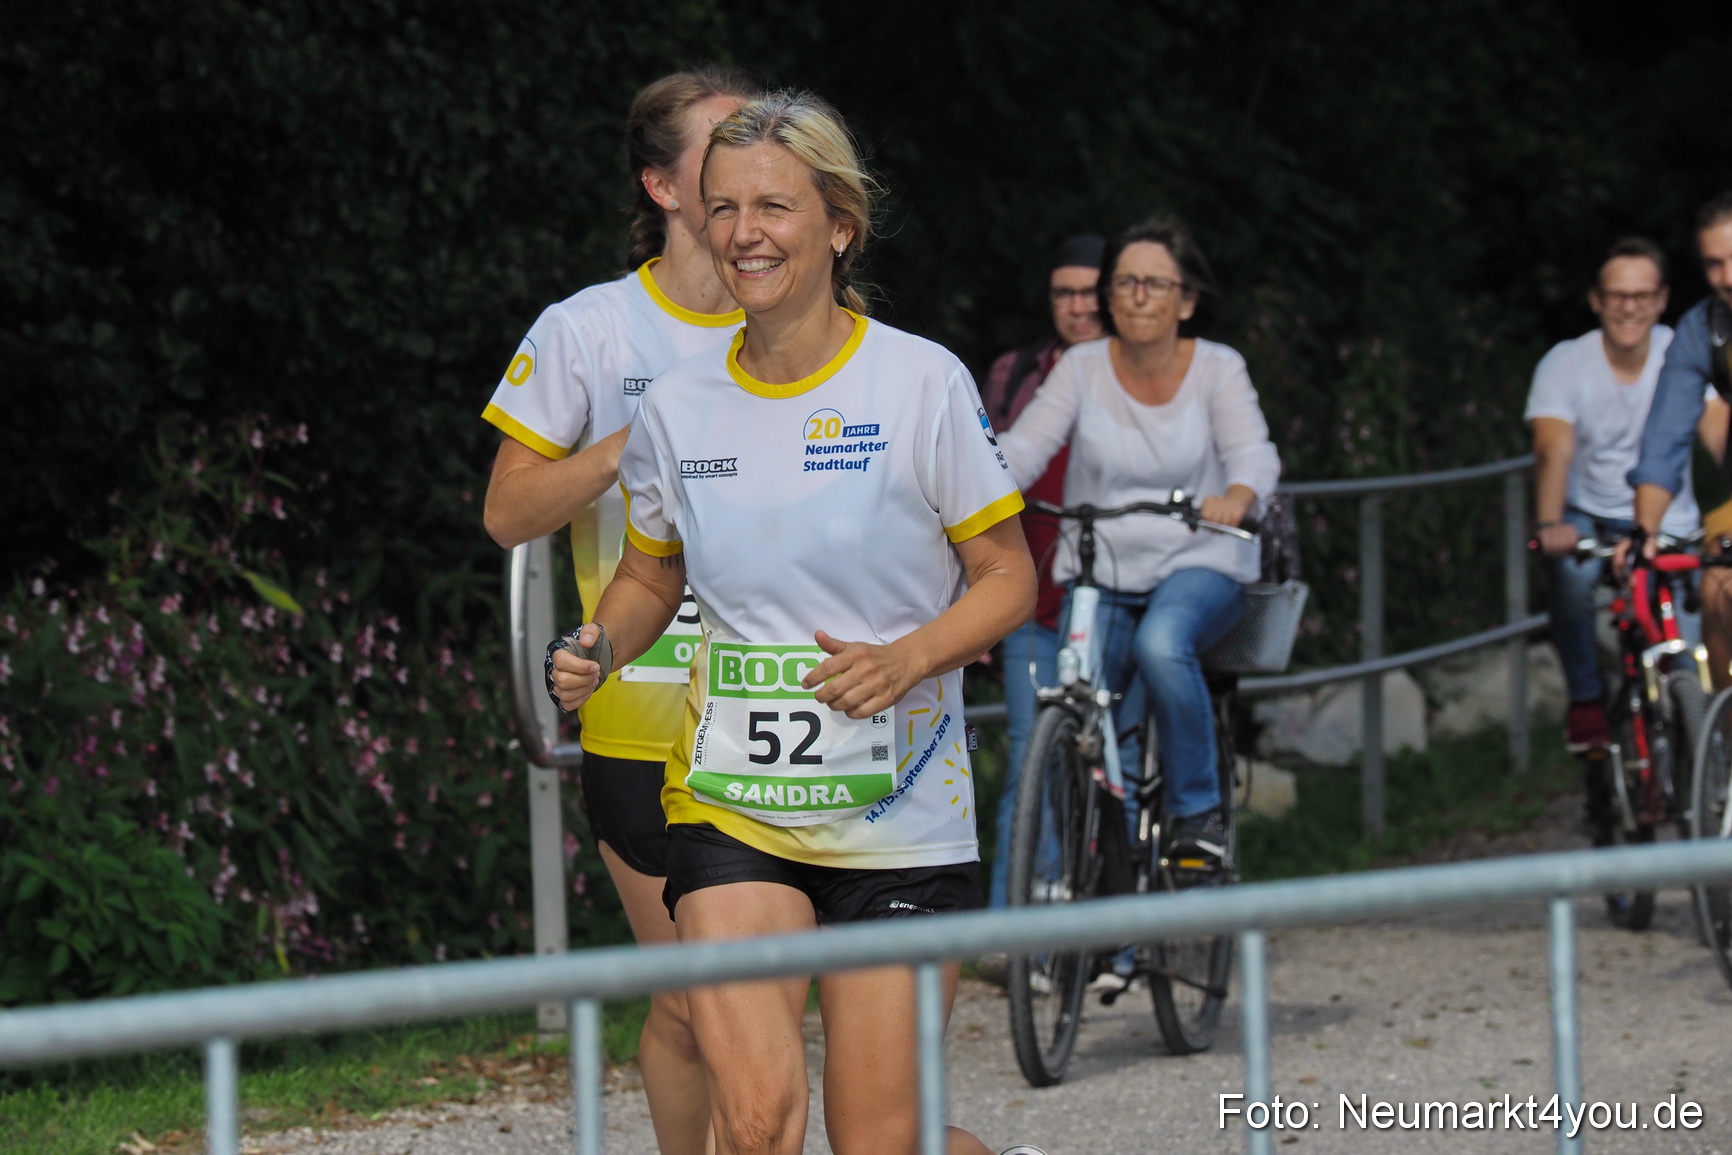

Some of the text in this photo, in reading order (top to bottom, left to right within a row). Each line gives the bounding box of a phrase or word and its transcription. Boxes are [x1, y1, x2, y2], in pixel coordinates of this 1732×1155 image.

[624, 377, 654, 392] BO
[807, 417, 877, 440] 20 JAHRE
[805, 440, 889, 456] Neumarkter
[681, 457, 738, 474] BOCK
[803, 457, 871, 472] Stadtlauf
[718, 650, 836, 693] BOC
[872, 715, 887, 724] E6
[935, 713, 951, 741] 2019
[748, 711, 823, 766] 52
[723, 782, 854, 807] SANDRA
